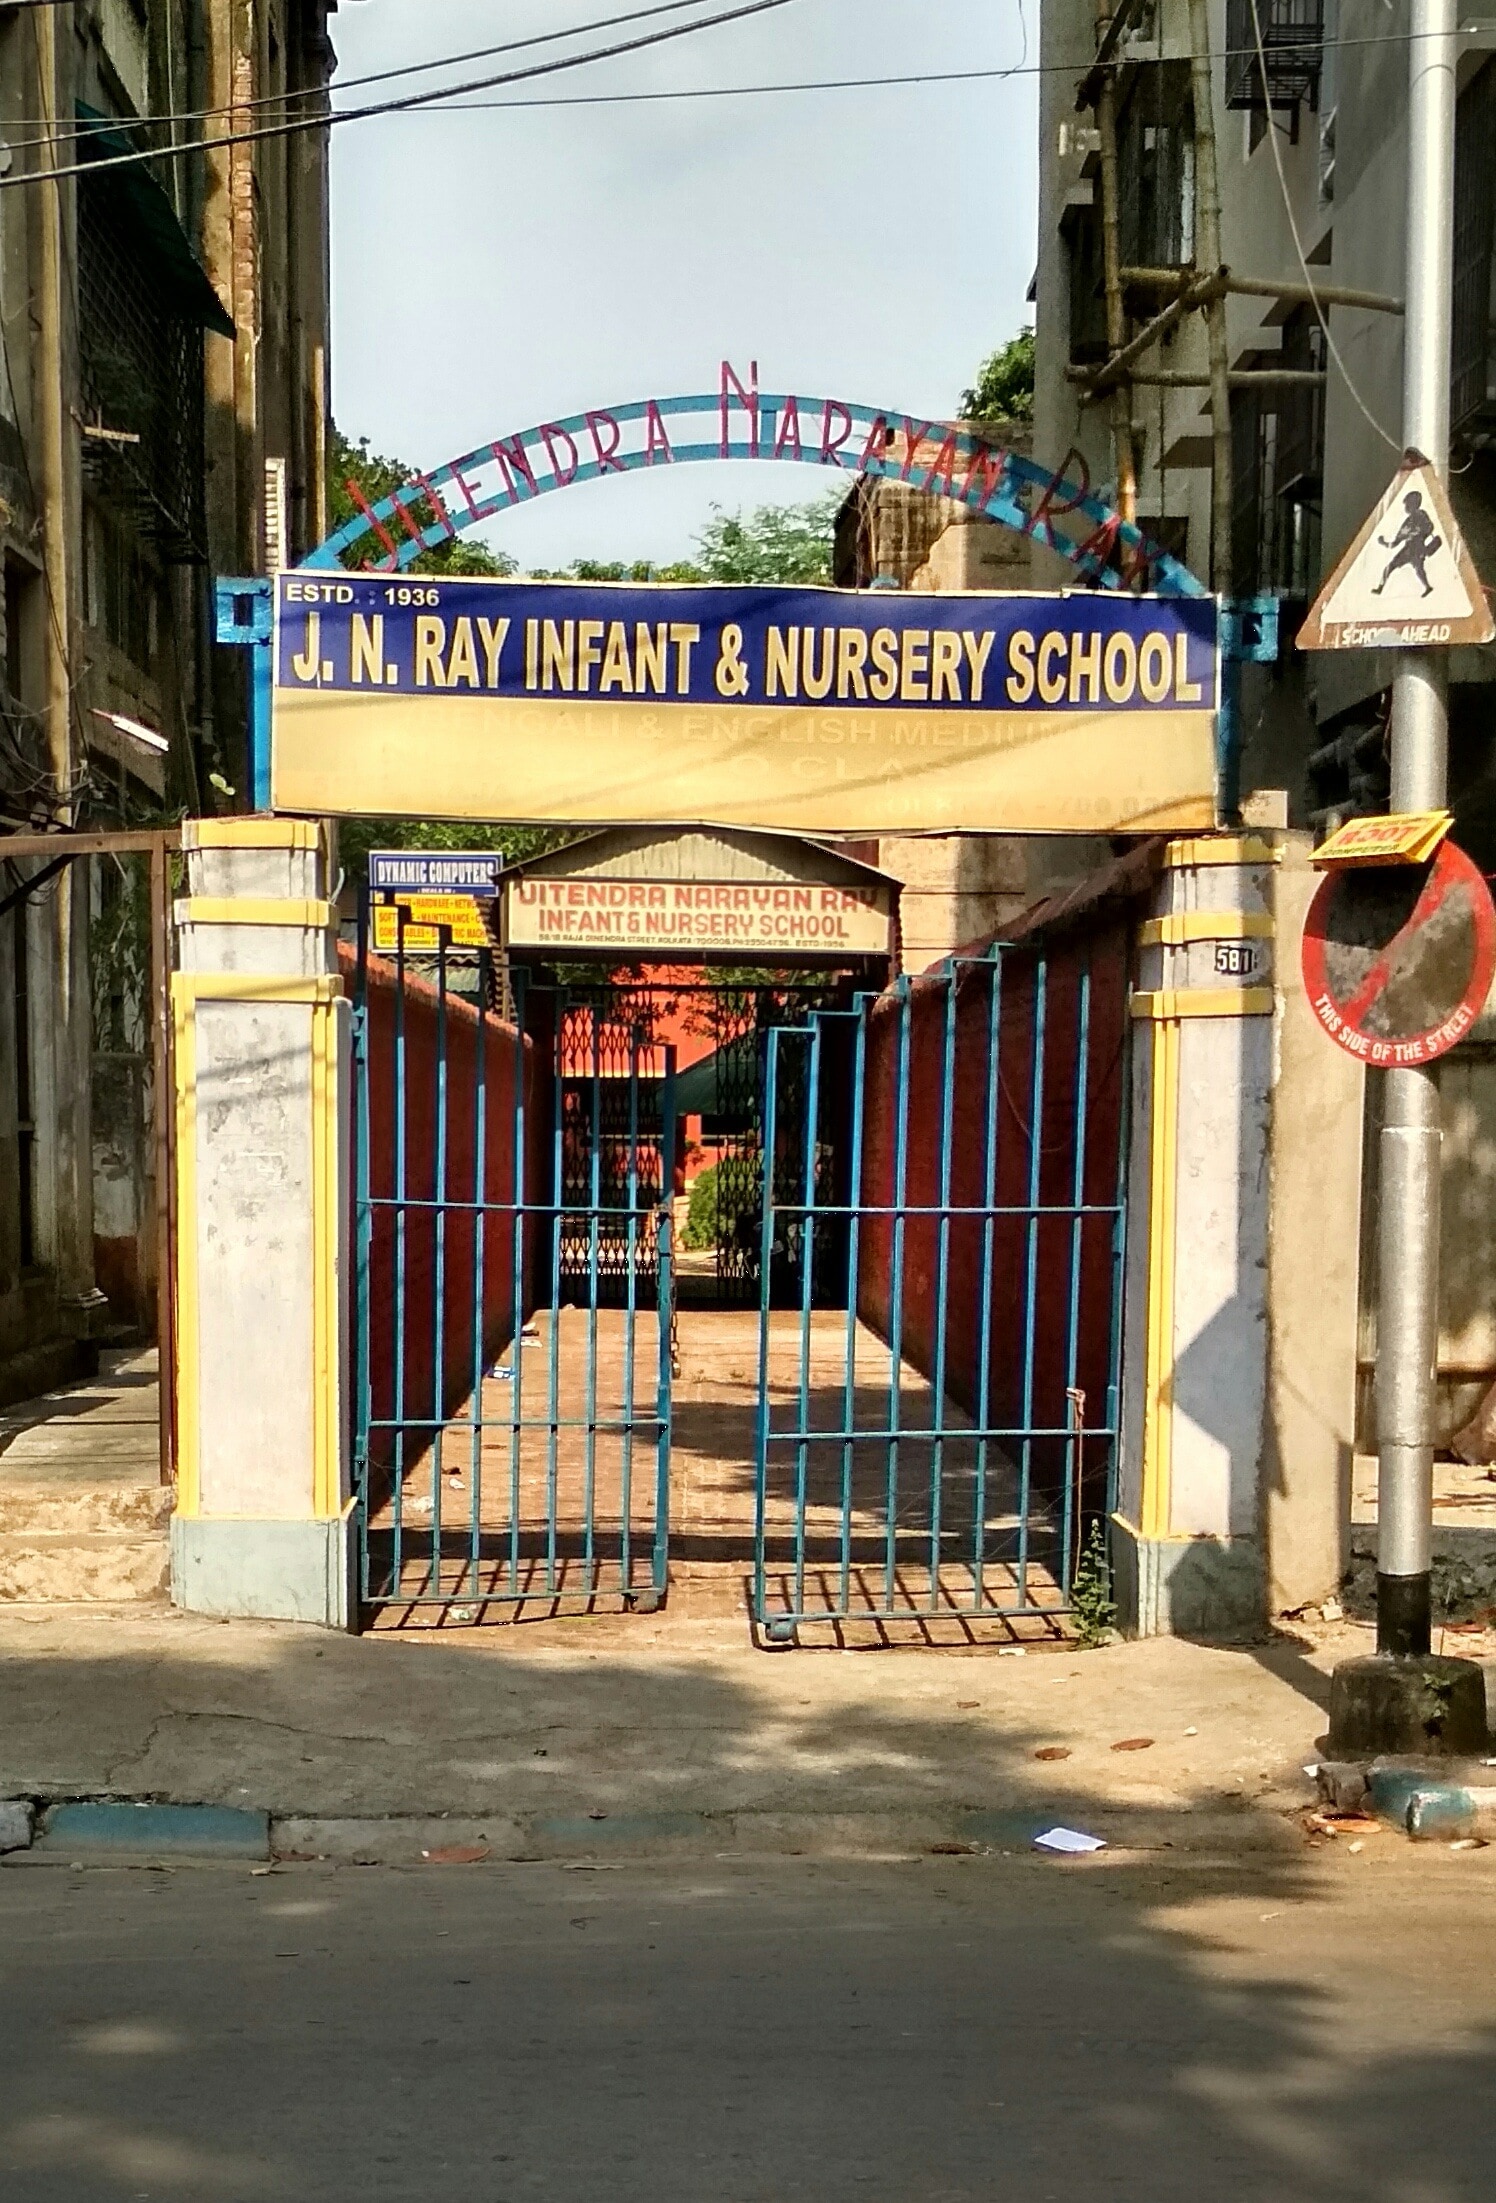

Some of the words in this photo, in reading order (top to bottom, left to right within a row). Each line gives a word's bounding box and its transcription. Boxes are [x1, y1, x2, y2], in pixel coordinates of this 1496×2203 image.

[345, 399, 674, 574] JITENDRA
[719, 360, 1008, 509] NARAYAN
[384, 588, 440, 607] 1936
[1400, 625, 1451, 642] AHEAD
[293, 610, 334, 682] J.
[352, 613, 399, 685] N.
[416, 614, 511, 688] RAY
[526, 618, 700, 694] INFANT
[716, 623, 749, 697] &
[765, 626, 996, 702] NURSERY
[1006, 630, 1202, 704] SCHOOL
[682, 714, 876, 744] ENGLISH
[378, 861, 428, 882] DYNAMIC
[429, 861, 495, 884] COMPUTERS
[519, 884, 666, 908] JITENDRA
[674, 887, 813, 911] NARAYAN
[820, 889, 878, 913] RAY
[539, 909, 624, 933] INFANT
[627, 912, 640, 934] &
[646, 912, 754, 937] NURSERY
[759, 915, 850, 938] SCHOOL
[1315, 993, 1342, 1032] THIS
[1338, 1025, 1371, 1056] SIDE
[1372, 1042, 1393, 1061] OF
[1394, 1041, 1424, 1062] THE
[1425, 1002, 1475, 1053] STREET
